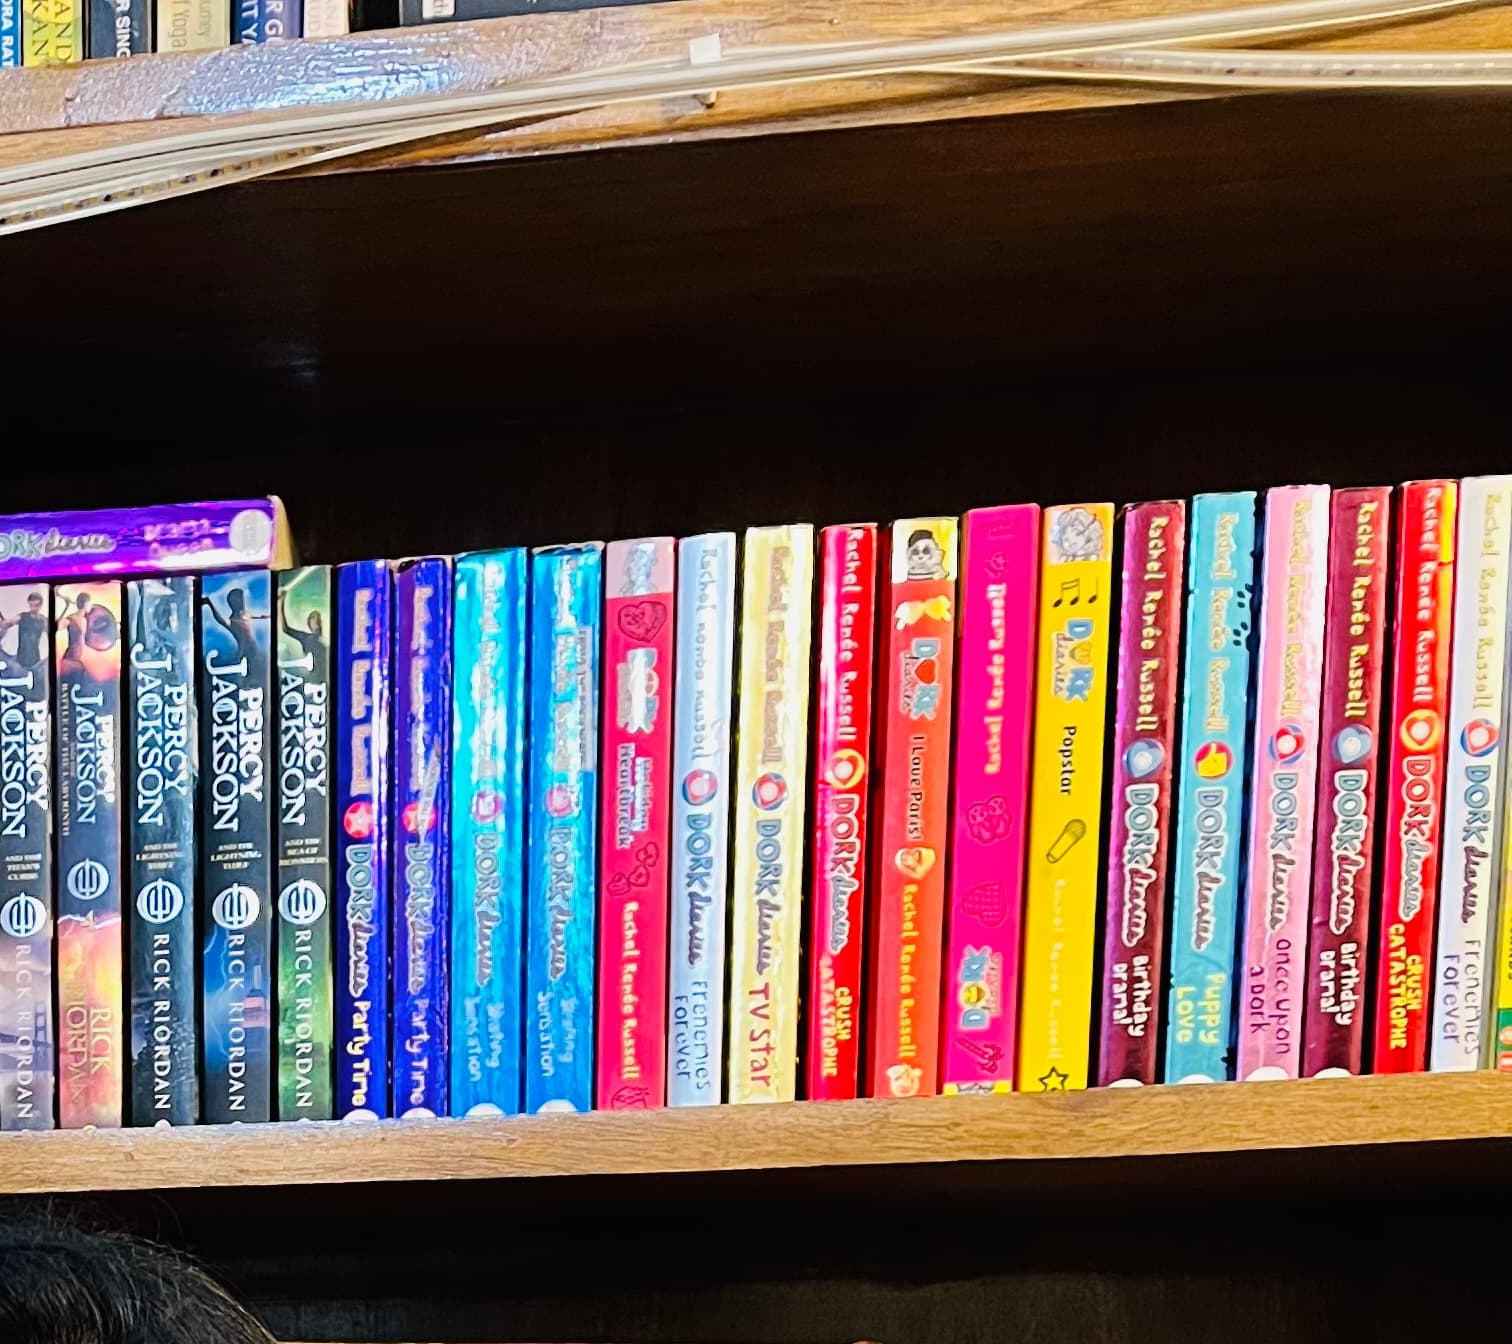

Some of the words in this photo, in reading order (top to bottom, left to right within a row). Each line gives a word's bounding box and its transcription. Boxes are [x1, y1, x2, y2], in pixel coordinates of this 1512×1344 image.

[1147, 515, 1170, 583] Rachel
[1141, 590, 1164, 651] Renée
[1134, 657, 1159, 731] Russell
[133, 643, 172, 827] JACKSON
[163, 682, 186, 797] PERCY
[274, 644, 314, 826] JACKSON
[302, 681, 326, 795] PERCY
[1060, 725, 1078, 797] Popstar
[152, 932, 172, 992] RICK
[295, 928, 313, 988] RICK
[747, 981, 771, 1018] TV
[153, 999, 173, 1111] RIORDAN
[296, 997, 314, 1109] RIORDAN
[746, 1023, 772, 1088] Star
